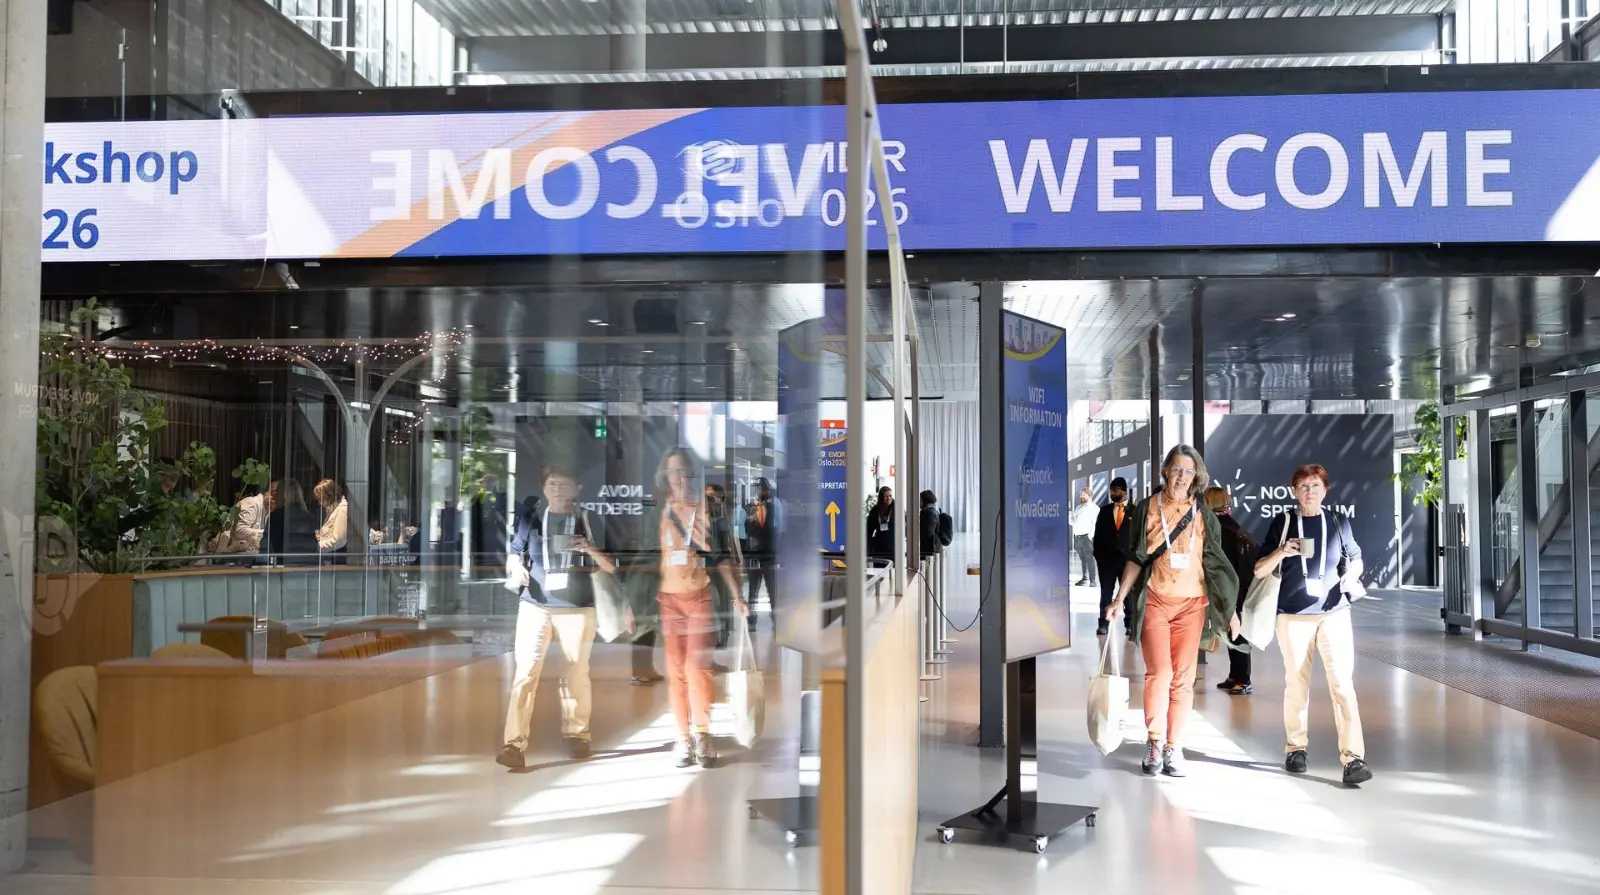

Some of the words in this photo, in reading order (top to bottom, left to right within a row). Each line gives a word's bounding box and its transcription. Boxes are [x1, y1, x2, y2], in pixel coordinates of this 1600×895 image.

[45, 141, 198, 194] kshop
[989, 130, 1513, 213] WELCOME
[42, 208, 99, 249] 26
[1028, 386, 1045, 404] WIFI
[1009, 404, 1062, 428] INFORMATION
[1020, 466, 1053, 484] Network:
[1015, 499, 1060, 517] NovaGuest
